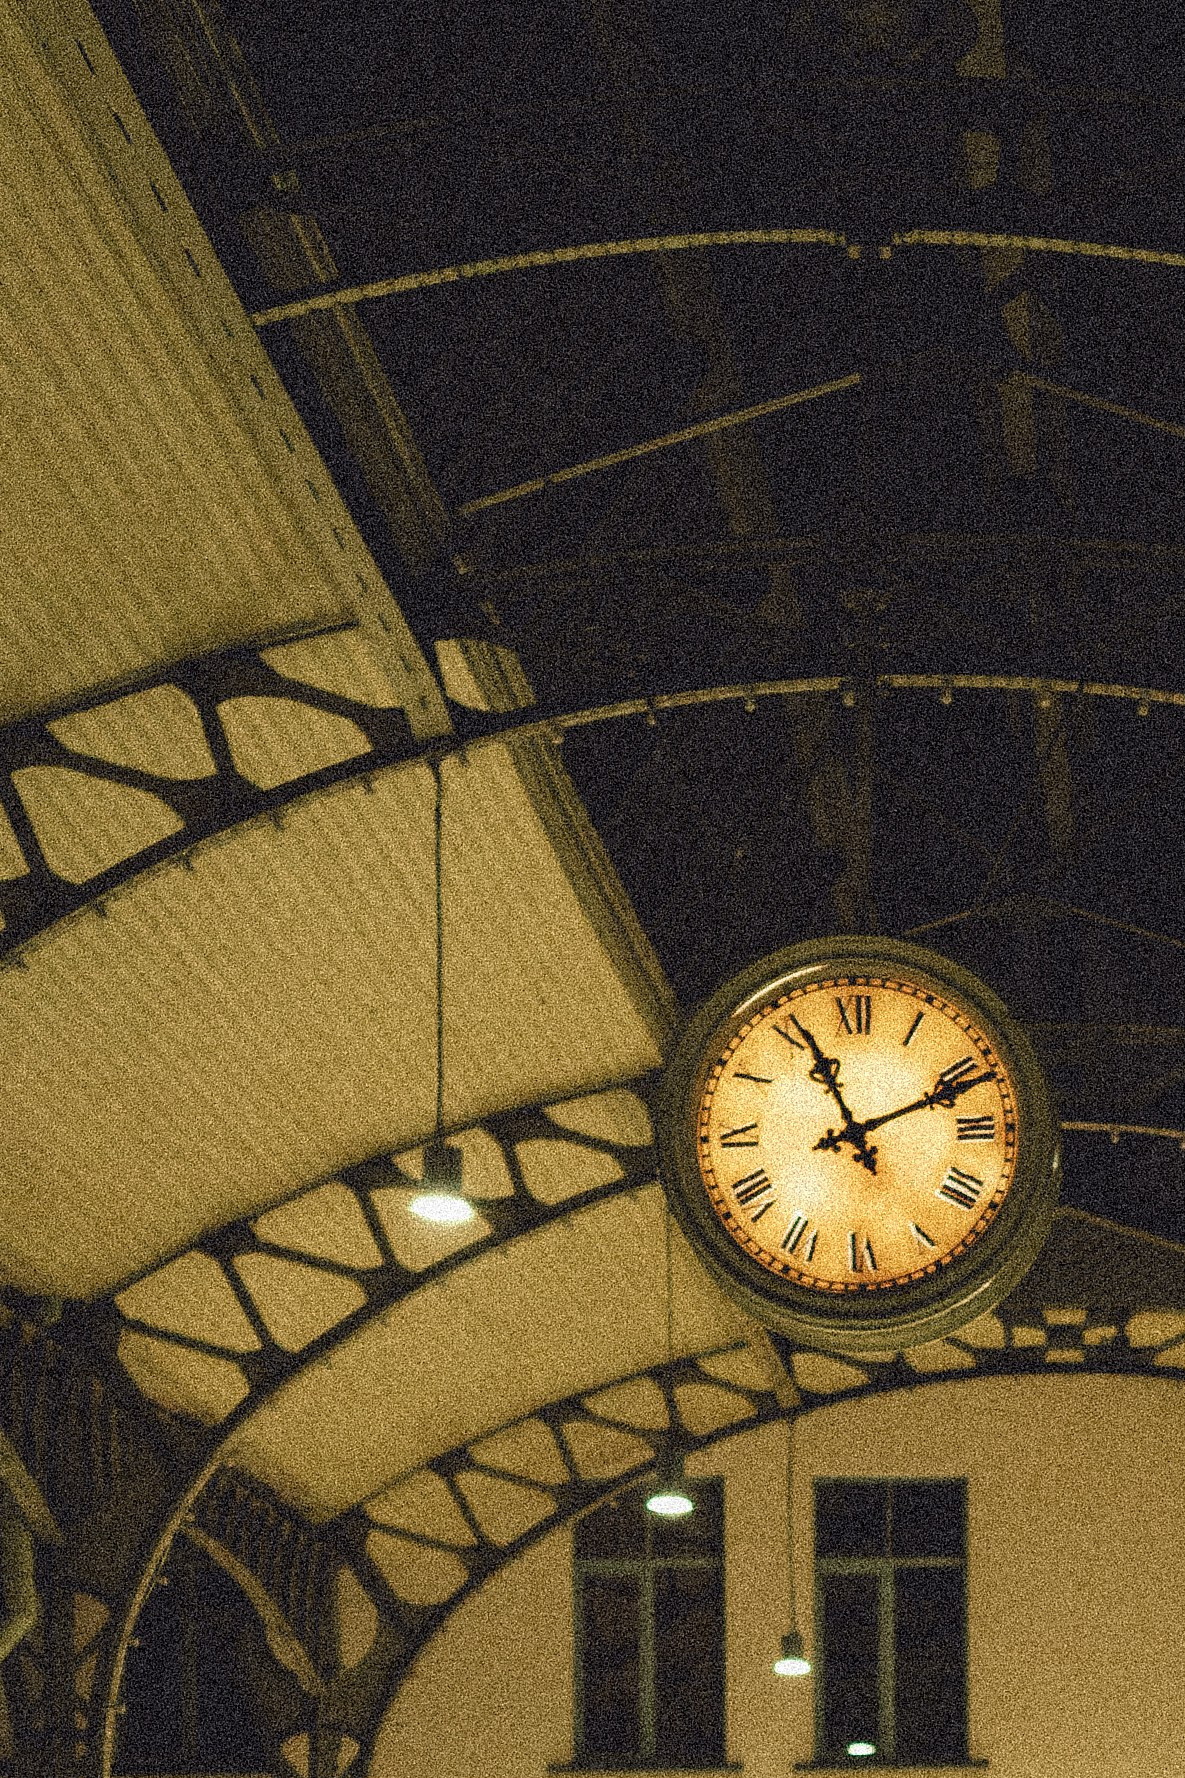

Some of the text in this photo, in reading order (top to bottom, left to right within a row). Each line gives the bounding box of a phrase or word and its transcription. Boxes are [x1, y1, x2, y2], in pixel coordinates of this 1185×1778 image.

[835, 995, 871, 1035] XII
[902, 1011, 924, 1046] I
[957, 1115, 995, 1141] III
[732, 1168, 775, 1223] VIII
[781, 1216, 817, 1263] VII
[849, 1232, 878, 1272] VI
